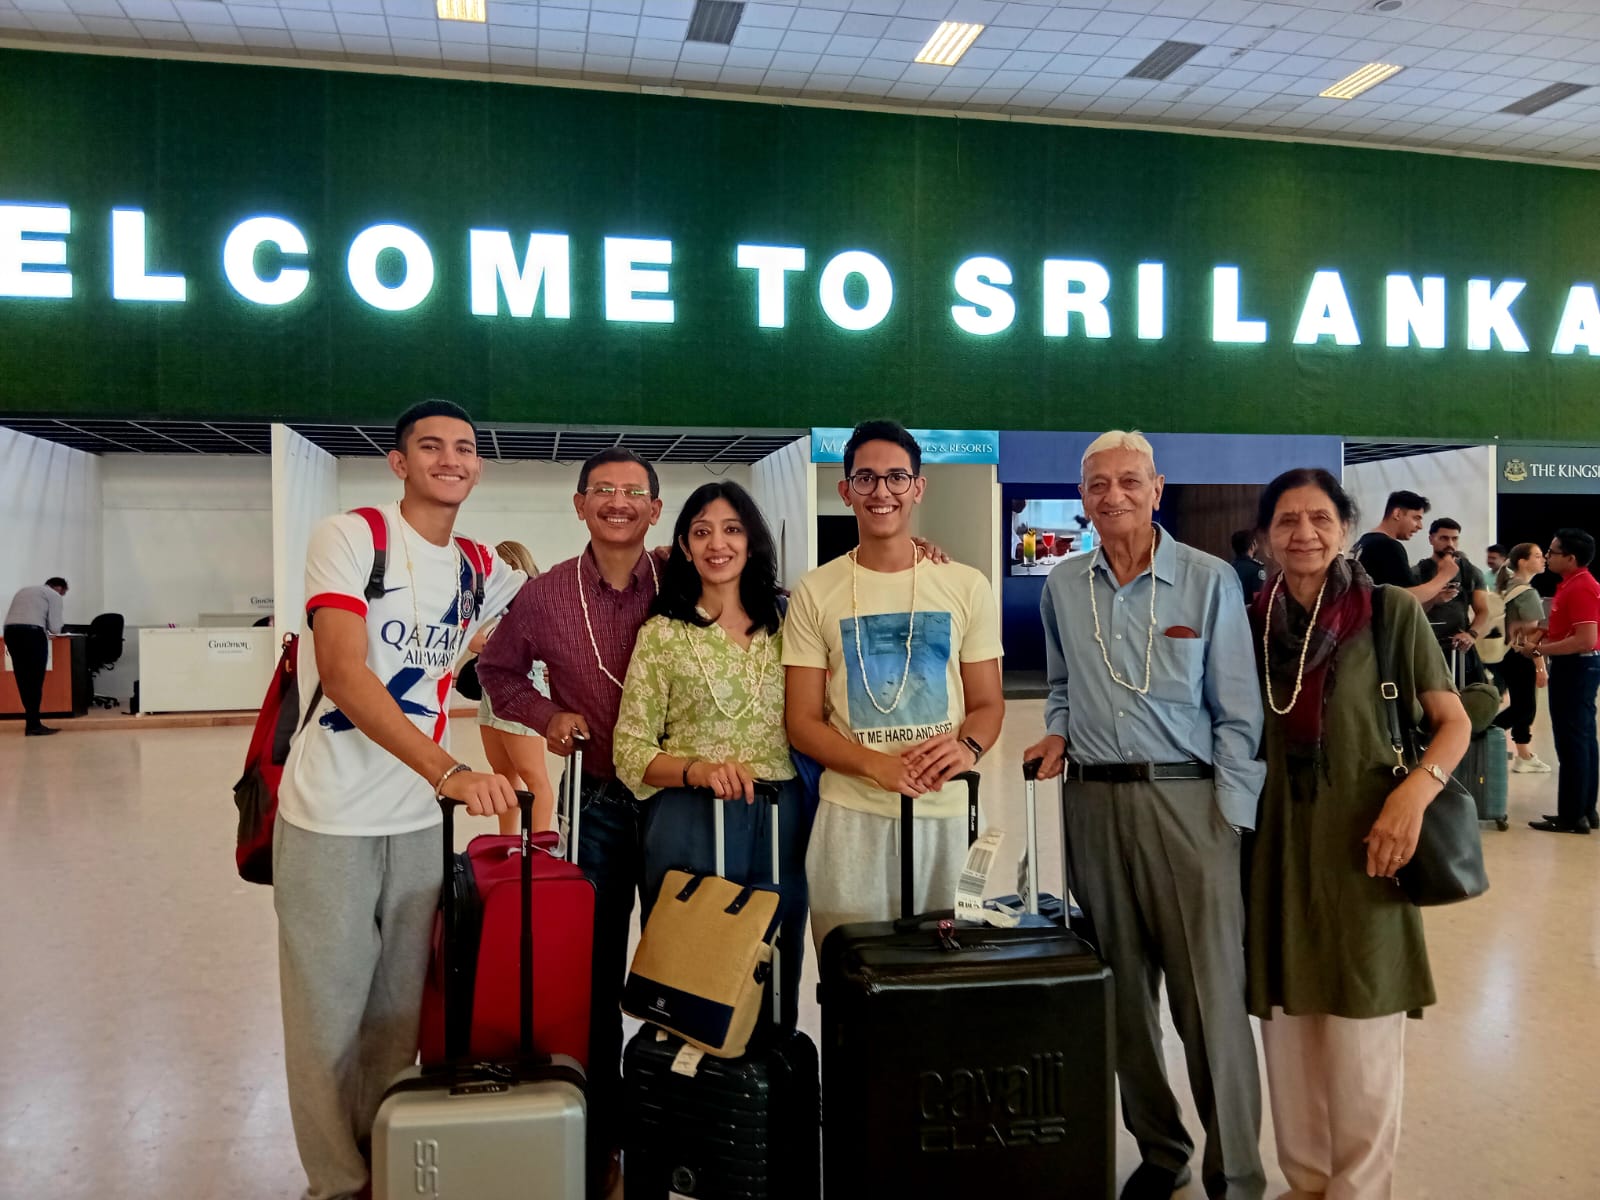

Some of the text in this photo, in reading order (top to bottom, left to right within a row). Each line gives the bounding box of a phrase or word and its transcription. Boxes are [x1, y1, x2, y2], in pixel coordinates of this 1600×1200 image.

[0, 204, 1600, 357] ELCOME TO SRI LANKA
[949, 443, 993, 453] RESORTS
[1530, 463, 1556, 477] THE
[868, 730, 882, 744] ME
[885, 728, 913, 742] HARD
[916, 726, 935, 741] AND
